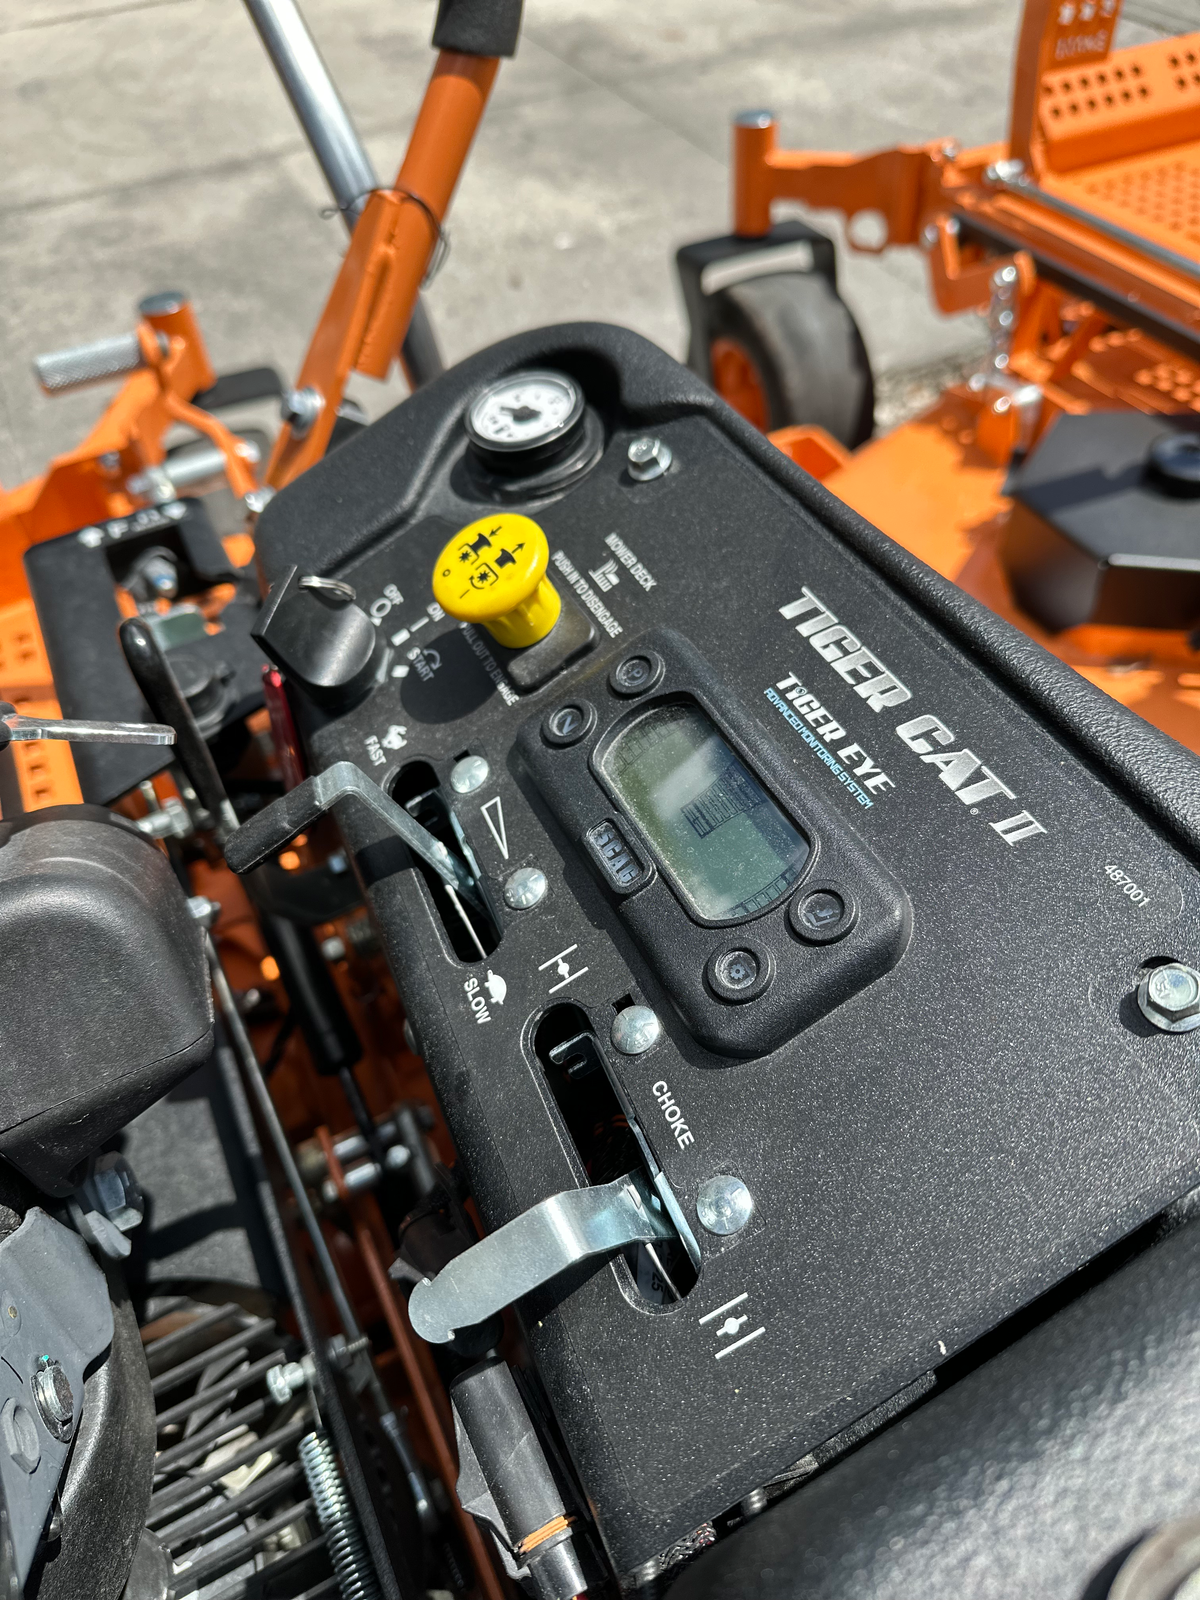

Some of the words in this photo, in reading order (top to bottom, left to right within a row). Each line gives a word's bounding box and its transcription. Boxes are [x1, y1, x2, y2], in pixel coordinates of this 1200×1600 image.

[551, 549, 574, 576] PUSH
[566, 570, 581, 585] IN
[604, 532, 638, 569] MOWER
[629, 562, 657, 592] DECK
[383, 583, 404, 605] OFF
[573, 578, 589, 595] TO
[426, 601, 446, 622] ON
[581, 588, 624, 638] DISENGAGE
[459, 621, 478, 645] PULL
[472, 640, 491, 660] OUT
[406, 647, 435, 682] START
[483, 656, 497, 672] TO
[489, 668, 520, 707] ENGAGE
[778, 585, 913, 713] TIGER
[895, 714, 1017, 806] CAT
[988, 810, 1048, 847] II
[363, 734, 387, 767] FAST
[763, 686, 804, 733] ADVANCED
[798, 725, 844, 776] MONITORING
[837, 770, 875, 810] SYSTEM
[837, 742, 896, 795] EYE
[596, 831, 639, 884] SCAG
[1103, 863, 1151, 908] 487001
[463, 976, 492, 1025] SLOW
[651, 1080, 695, 1150] CHOKE
